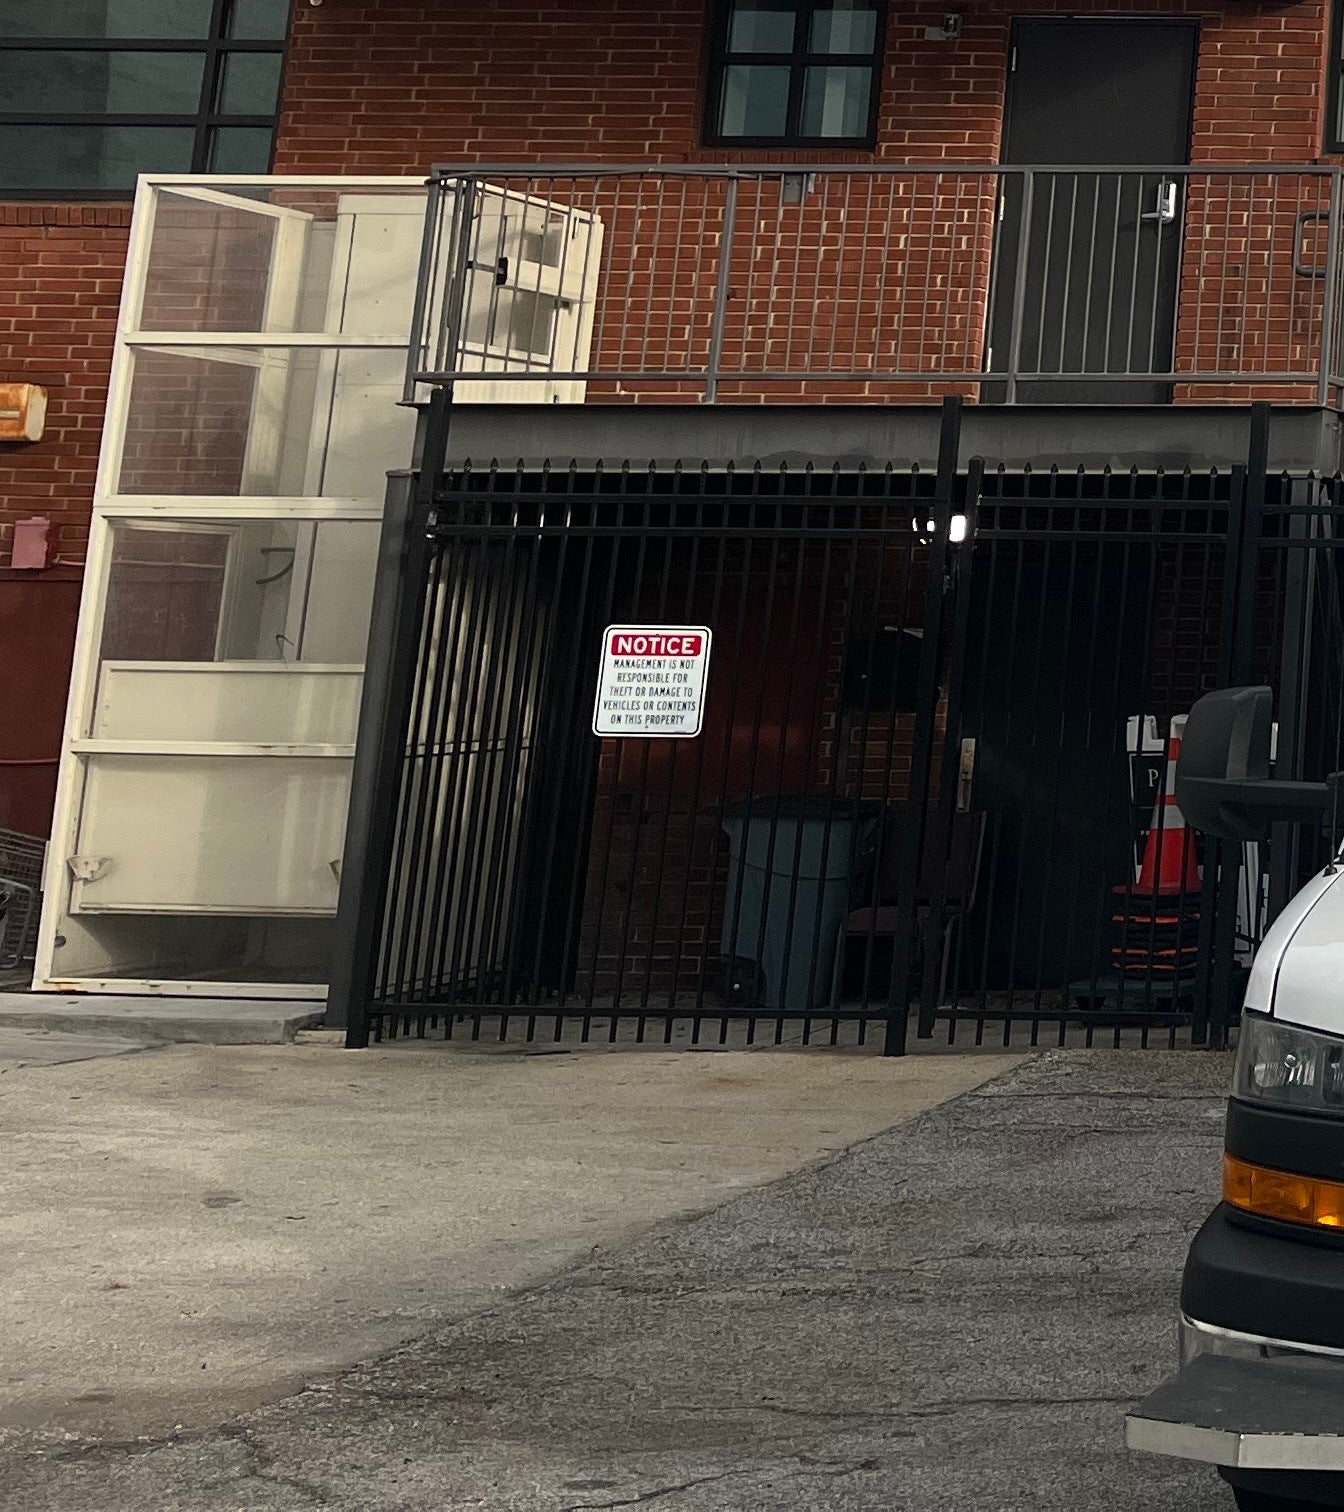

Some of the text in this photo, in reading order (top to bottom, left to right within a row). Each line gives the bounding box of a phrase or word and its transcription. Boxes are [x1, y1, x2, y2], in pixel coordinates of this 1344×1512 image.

[617, 636, 696, 655] NOTICE
[613, 659, 695, 670] MANAGEMENT IS NOT
[617, 672, 689, 684] RESPONSIBLE FOR
[609, 686, 693, 698] THEFT OR DAMAGE TO
[603, 700, 696, 712] VEHICLES OR CONTENTS
[610, 714, 685, 726] ON THIS PROPERTY
